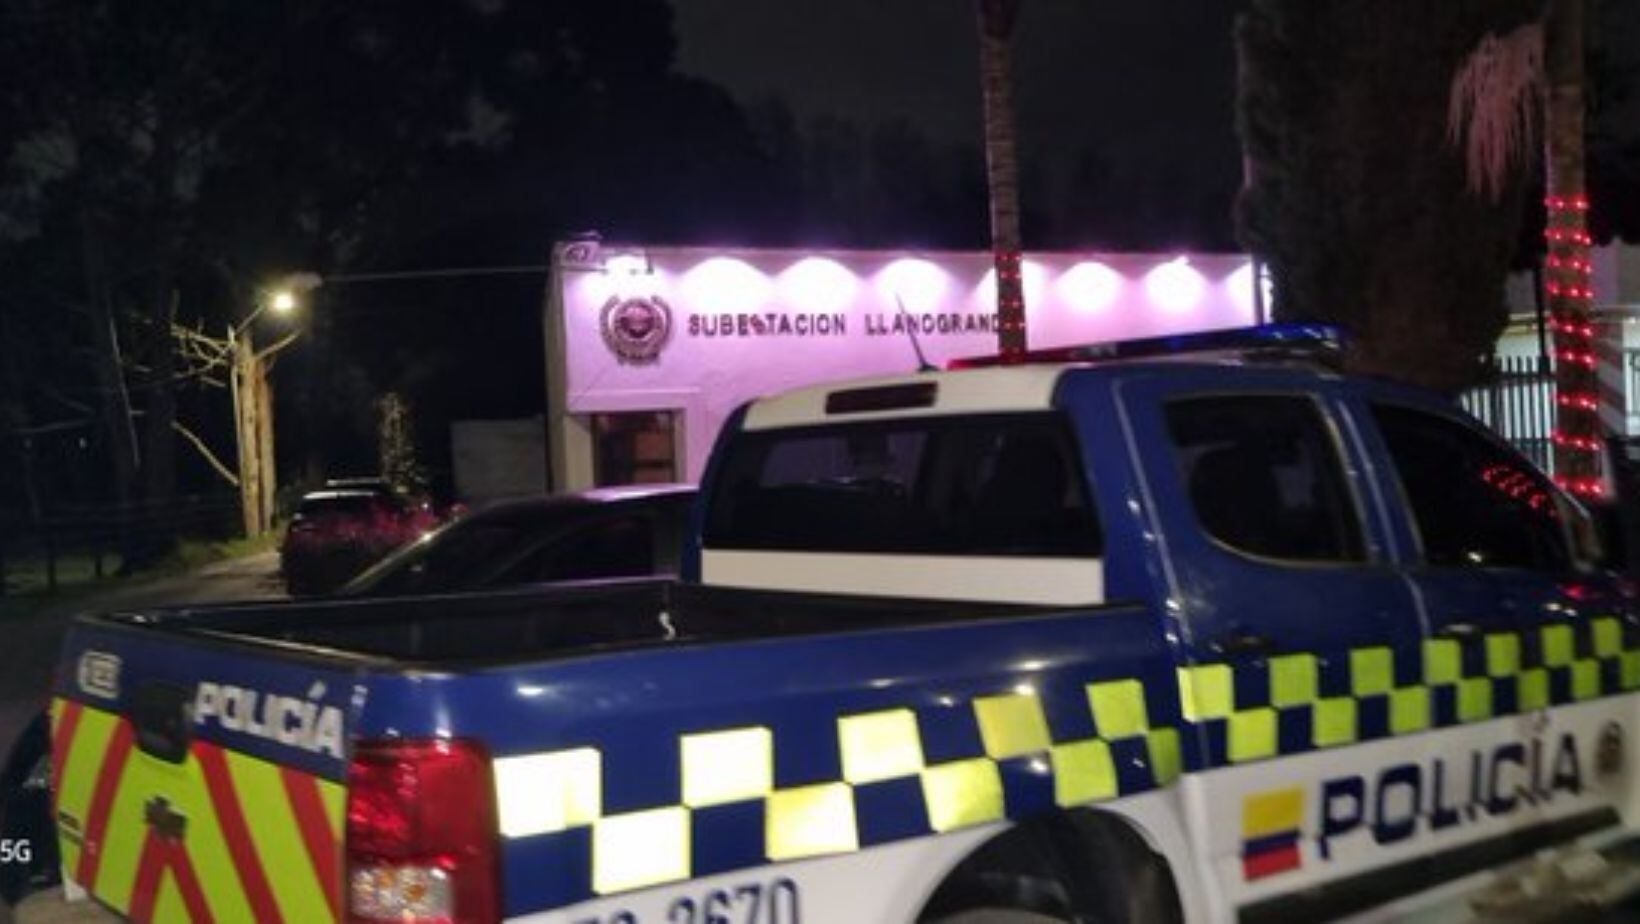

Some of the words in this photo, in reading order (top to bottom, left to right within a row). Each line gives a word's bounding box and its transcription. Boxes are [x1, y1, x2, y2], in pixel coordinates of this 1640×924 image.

[688, 313, 846, 336] SUBESTACION
[864, 313, 1000, 336] LLANOGRAND
[193, 680, 345, 759] POLICÍA
